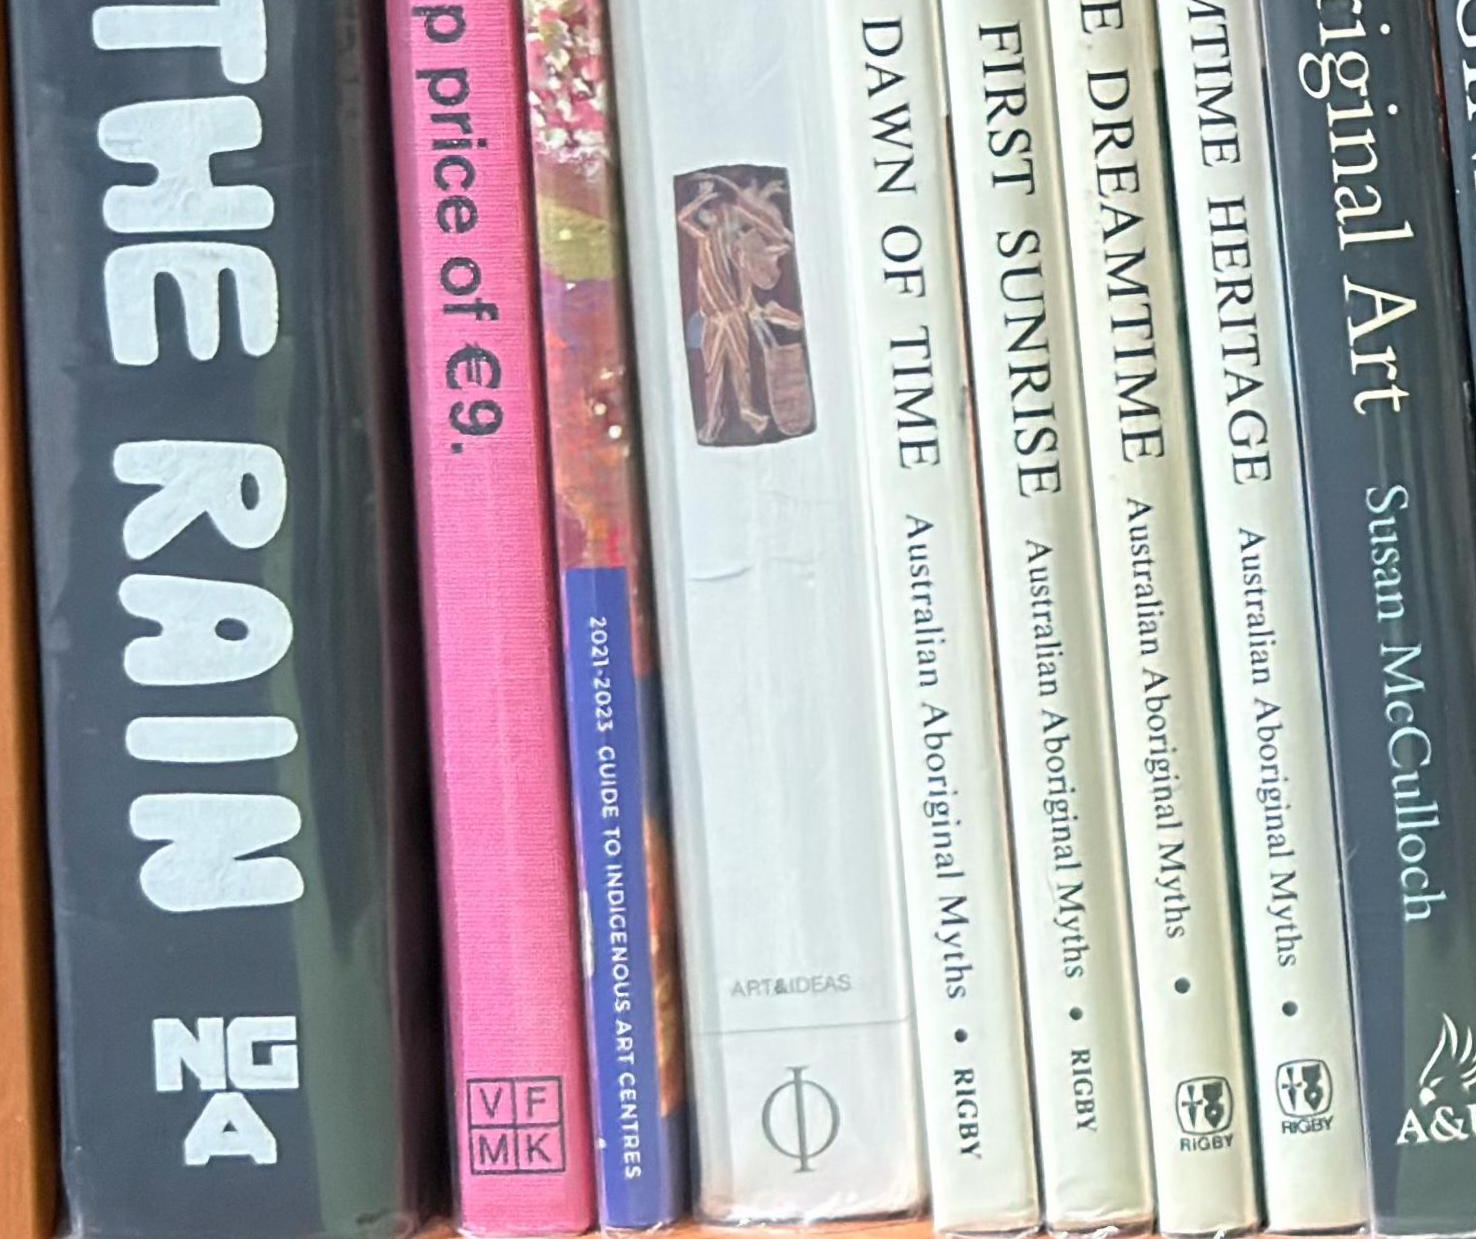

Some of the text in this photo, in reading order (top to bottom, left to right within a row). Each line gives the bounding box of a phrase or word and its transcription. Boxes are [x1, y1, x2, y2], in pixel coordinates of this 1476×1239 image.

[416, 68, 486, 235] price
[862, 18, 917, 195] DAWN
[978, 22, 1035, 196] FIRST
[440, 257, 498, 322] of
[880, 225, 926, 299] OF
[1087, 68, 1165, 463] DREAMTIME
[446, 342, 502, 454] €9.
[890, 325, 940, 470] TIME
[996, 228, 1061, 498] SUNRISE
[1207, 195, 1272, 485] HERITAGE
[1342, 274, 1417, 415] Art
[905, 514, 946, 687] Australian
[1026, 539, 1064, 697] Australian
[1126, 497, 1165, 656] Australian
[1238, 528, 1277, 686] Australian
[1366, 484, 1409, 623] Susan
[113, 439, 304, 912] RAIN
[598, 746, 619, 818] GUIDE
[920, 702, 964, 880] Aboriginal
[1041, 708, 1082, 872] Aboriginal
[1142, 667, 1184, 832] Aboriginal
[1254, 697, 1294, 859] Aboriginal
[1380, 642, 1447, 922] McCulloch
[604, 827, 621, 856] TO
[1155, 842, 1193, 939] Myths
[606, 864, 630, 1012] INDIGENOUS
[730, 974, 853, 998] ART&IDEAS
[935, 895, 974, 1000] Myths
[1053, 881, 1088, 979] Myths
[1270, 871, 1303, 968] Myths
[615, 1016, 636, 1066] ART
[954, 1067, 982, 1158] RIGBY
[1071, 1048, 1098, 1132] RIGBY
[619, 1072, 642, 1180] CENTRES
[1179, 1133, 1234, 1152] RIGBY
[1281, 1115, 1334, 1135] RIGBY
